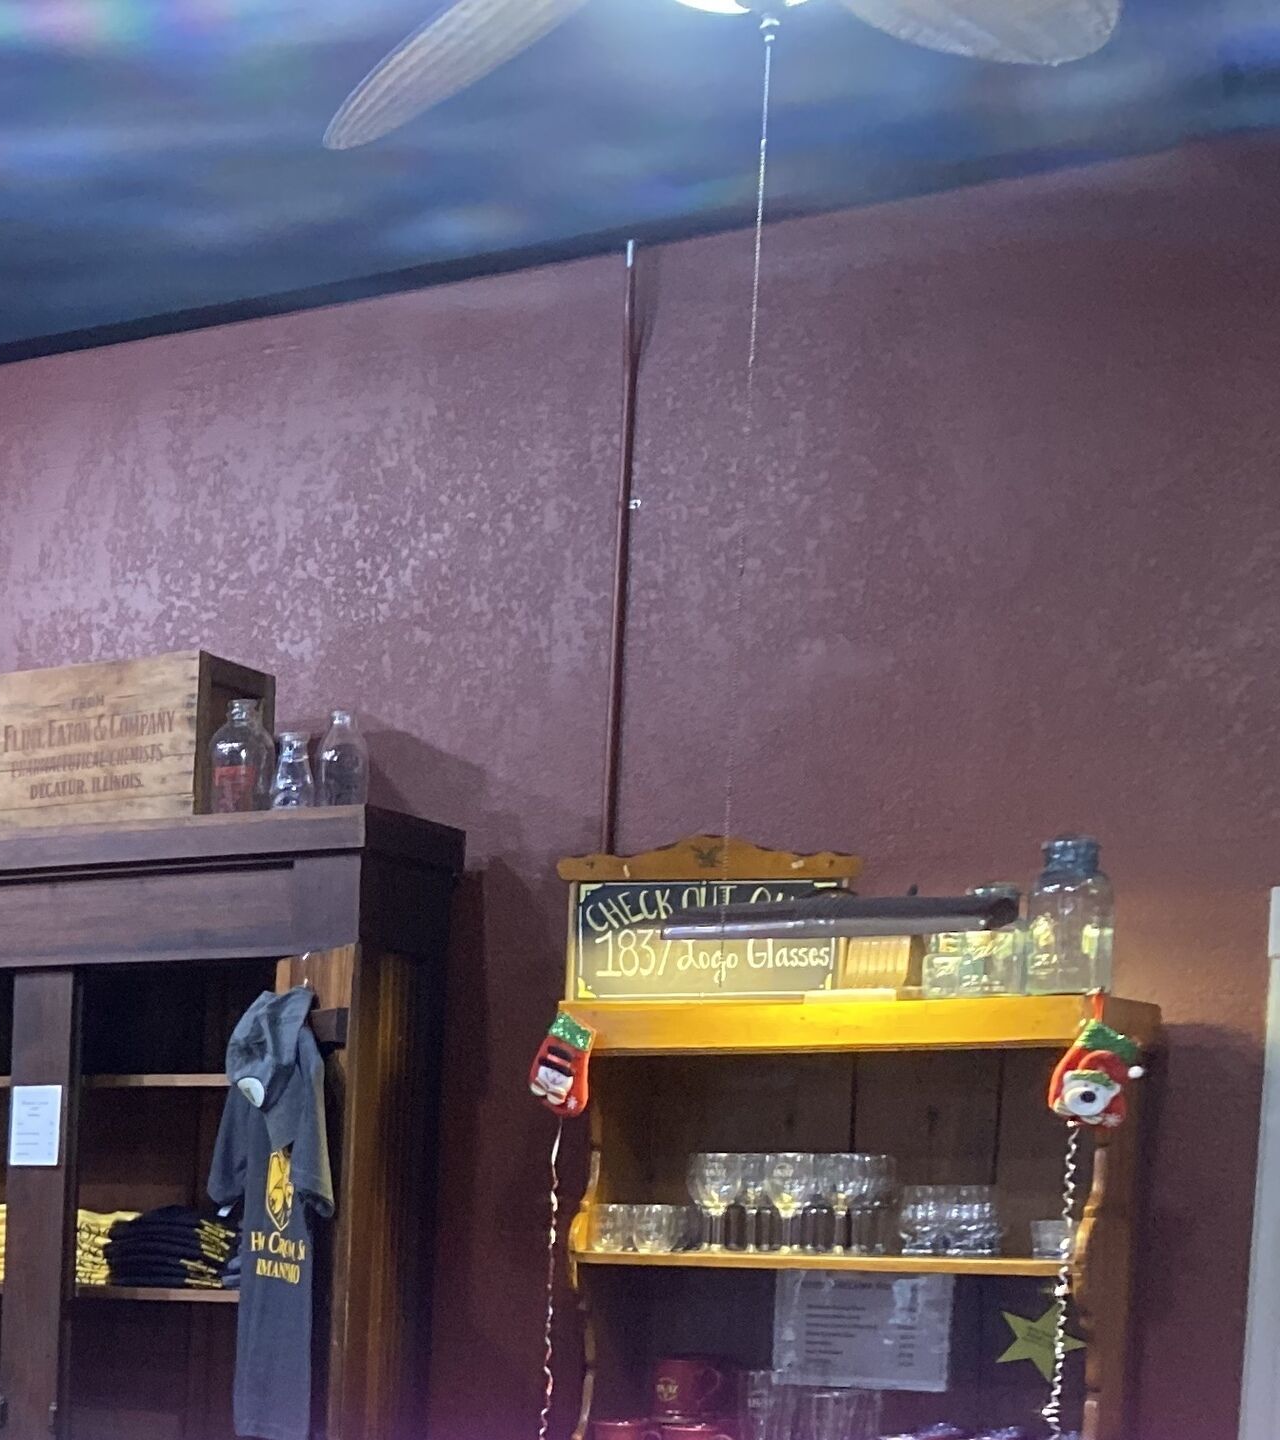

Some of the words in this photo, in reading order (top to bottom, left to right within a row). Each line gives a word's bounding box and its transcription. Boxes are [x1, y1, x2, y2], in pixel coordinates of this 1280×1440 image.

[47, 716, 90, 750] EATON
[92, 712, 108, 742] &
[109, 710, 177, 740] COMPANY
[585, 888, 674, 933] CHECK
[595, 927, 674, 978] 1837
[746, 937, 830, 970] Glasses
